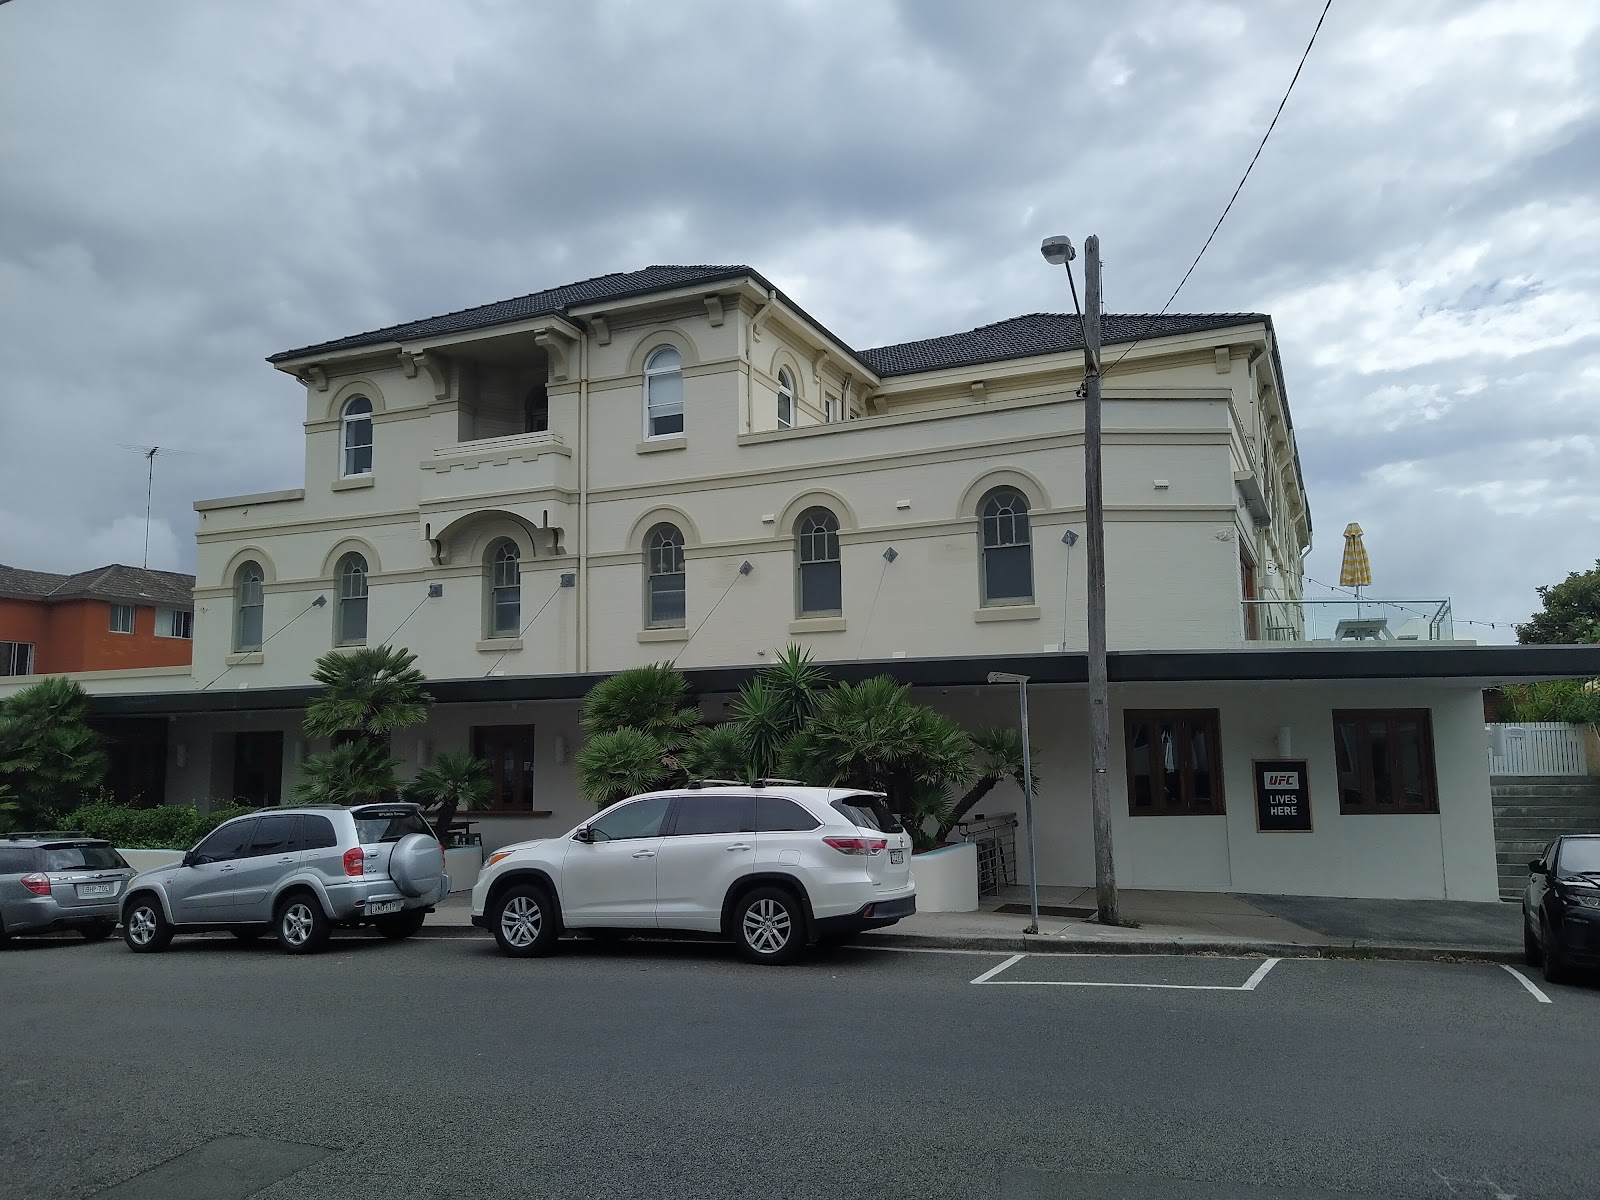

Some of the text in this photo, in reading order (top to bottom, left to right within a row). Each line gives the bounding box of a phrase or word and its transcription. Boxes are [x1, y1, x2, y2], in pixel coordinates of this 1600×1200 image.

[1269, 775, 1294, 785] UFC
[1270, 795, 1298, 804] LIVES
[1270, 806, 1298, 815] HERE
